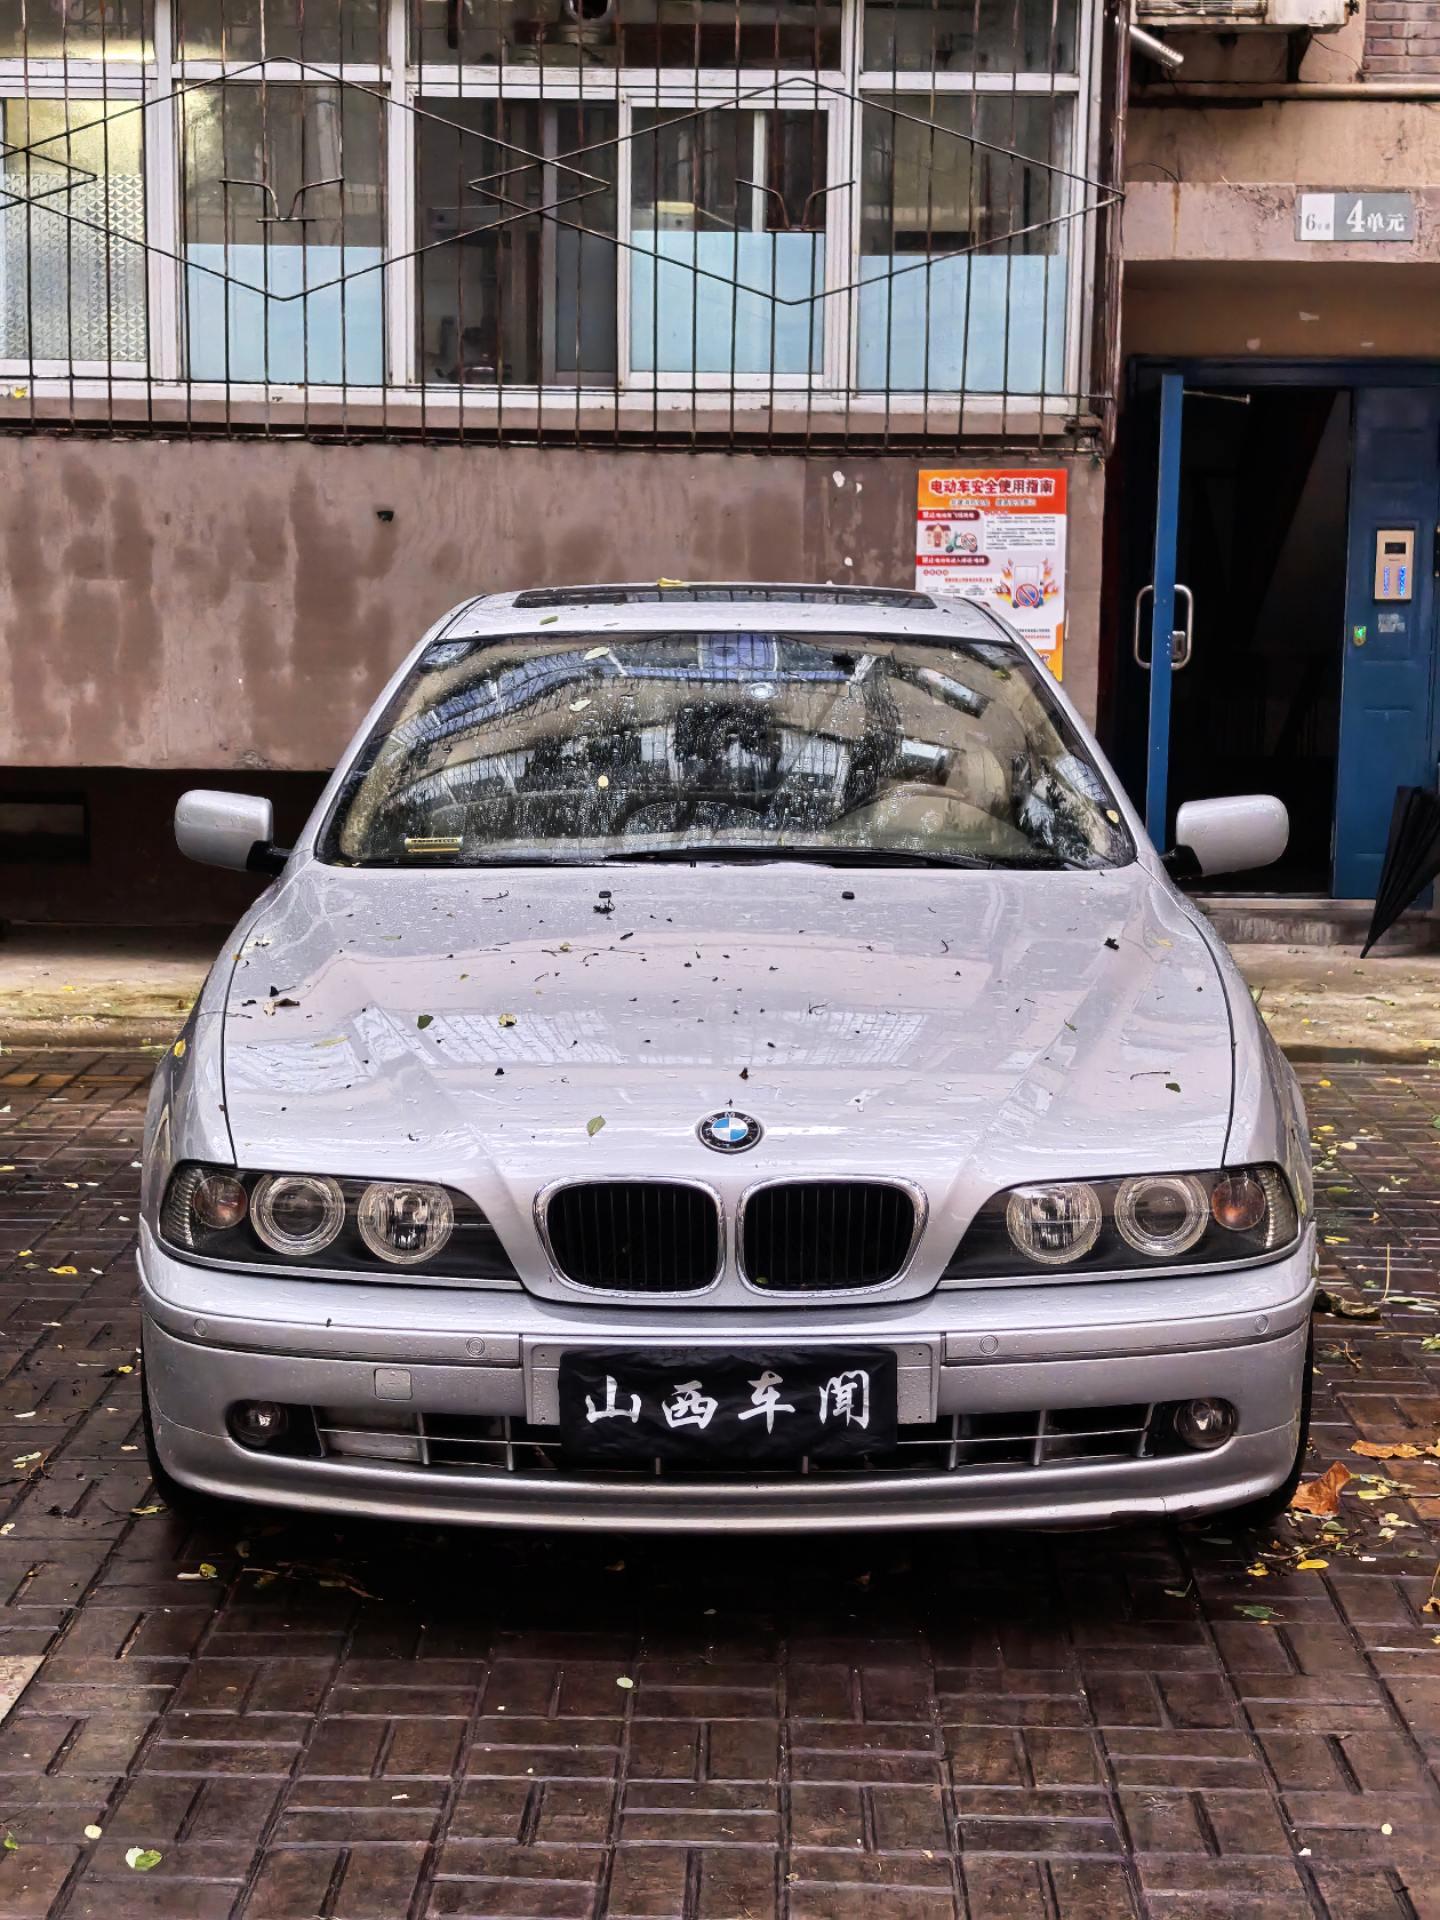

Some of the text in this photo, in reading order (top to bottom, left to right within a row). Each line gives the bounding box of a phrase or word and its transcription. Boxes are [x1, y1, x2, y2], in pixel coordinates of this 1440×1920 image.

[1346, 199, 1408, 233] 4单元
[930, 478, 1054, 496] 电动车安全使用指南
